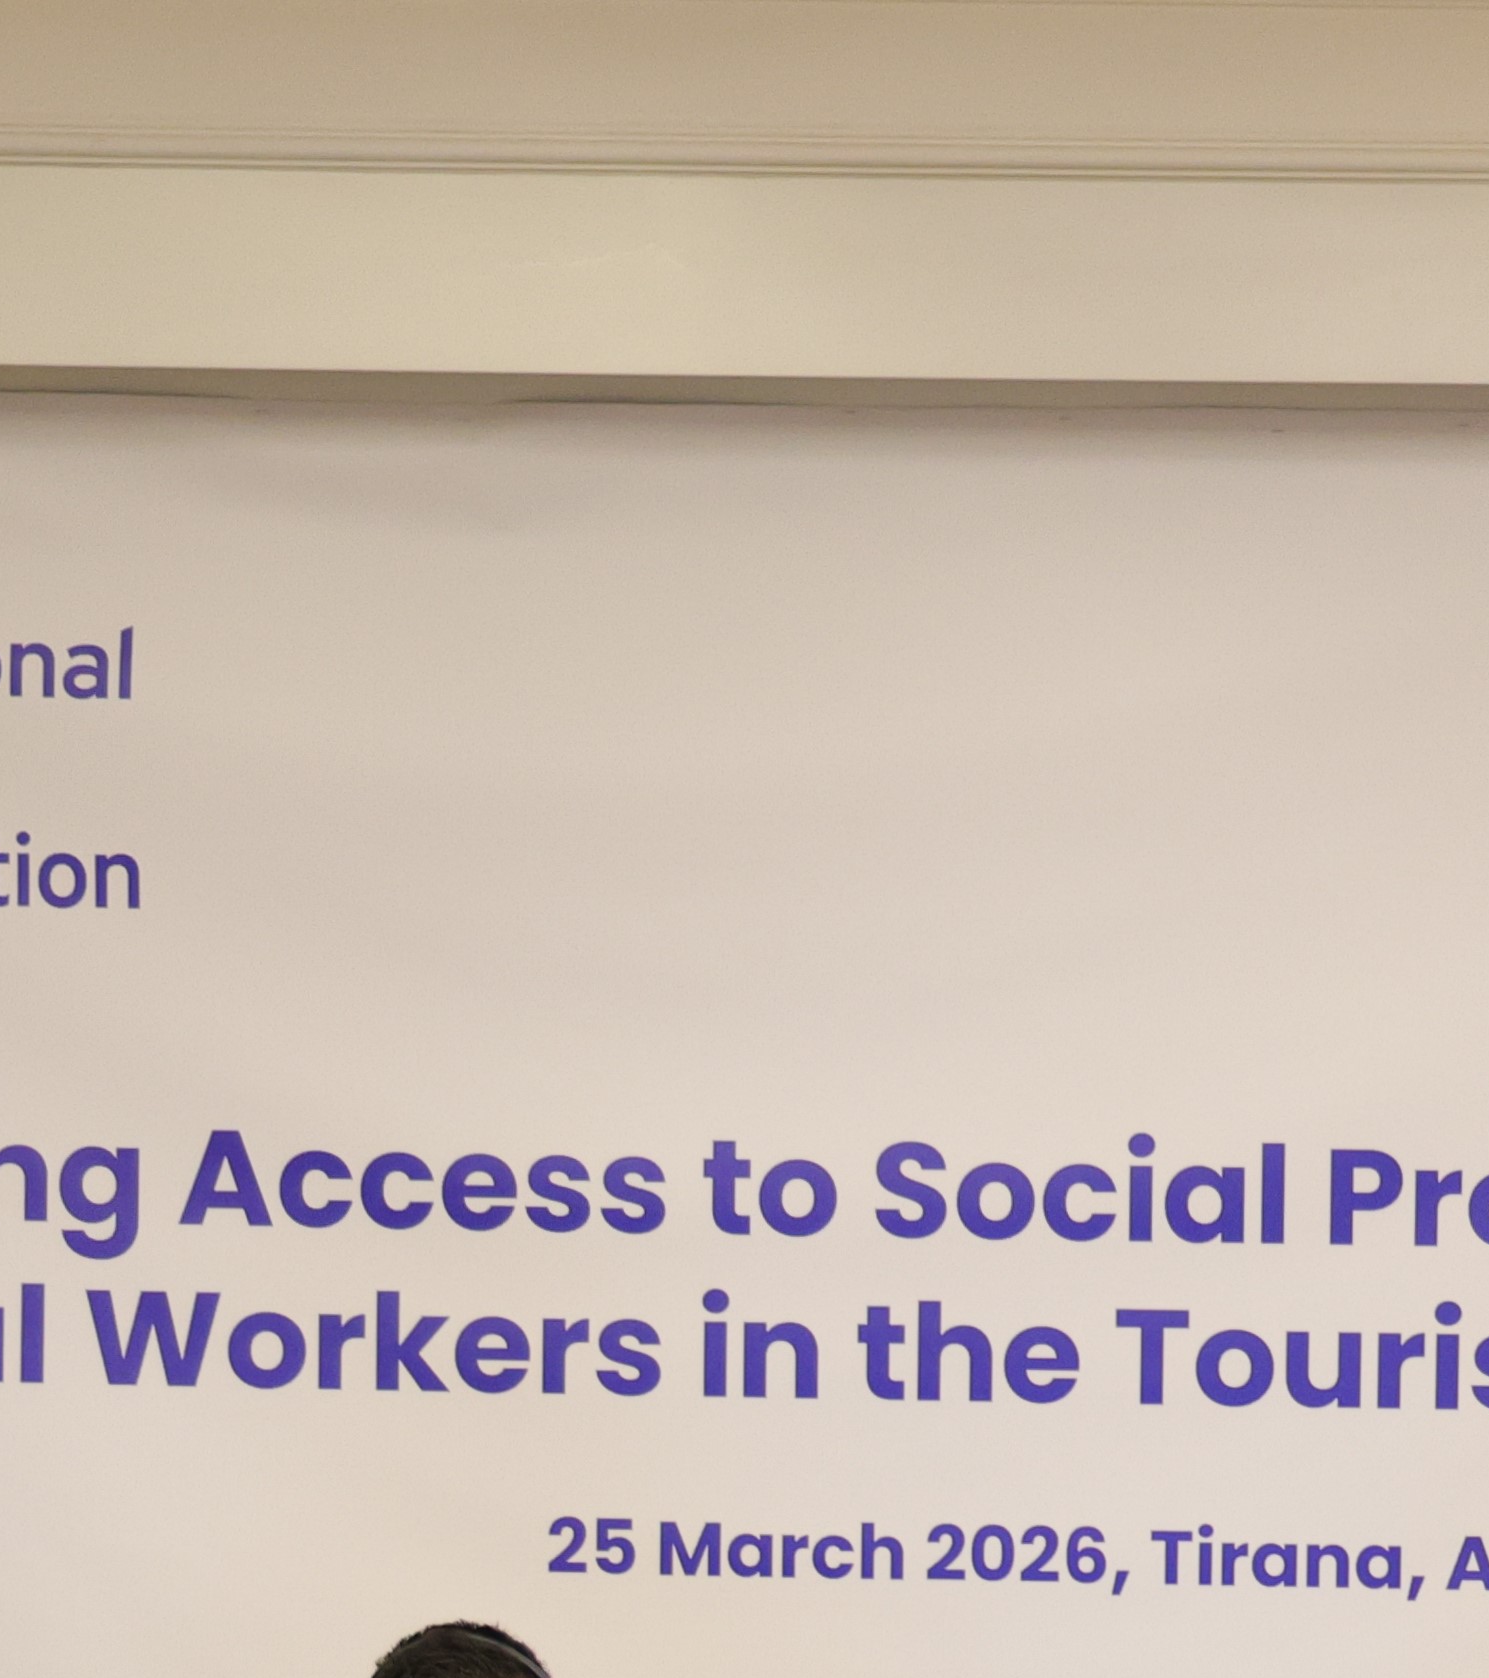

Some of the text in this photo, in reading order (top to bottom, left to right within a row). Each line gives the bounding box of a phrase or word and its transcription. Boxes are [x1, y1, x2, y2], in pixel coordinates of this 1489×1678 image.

[179, 1130, 665, 1234] Access
[704, 1141, 837, 1237] to
[876, 1133, 1285, 1244] Social
[86, 1290, 660, 1396] Workers
[703, 1289, 818, 1398] in
[858, 1301, 1079, 1404] the
[549, 1517, 635, 1574] 25
[660, 1522, 903, 1579] March
[927, 1524, 1129, 1595] 2026,
[1151, 1524, 1424, 1600] Tirana,
